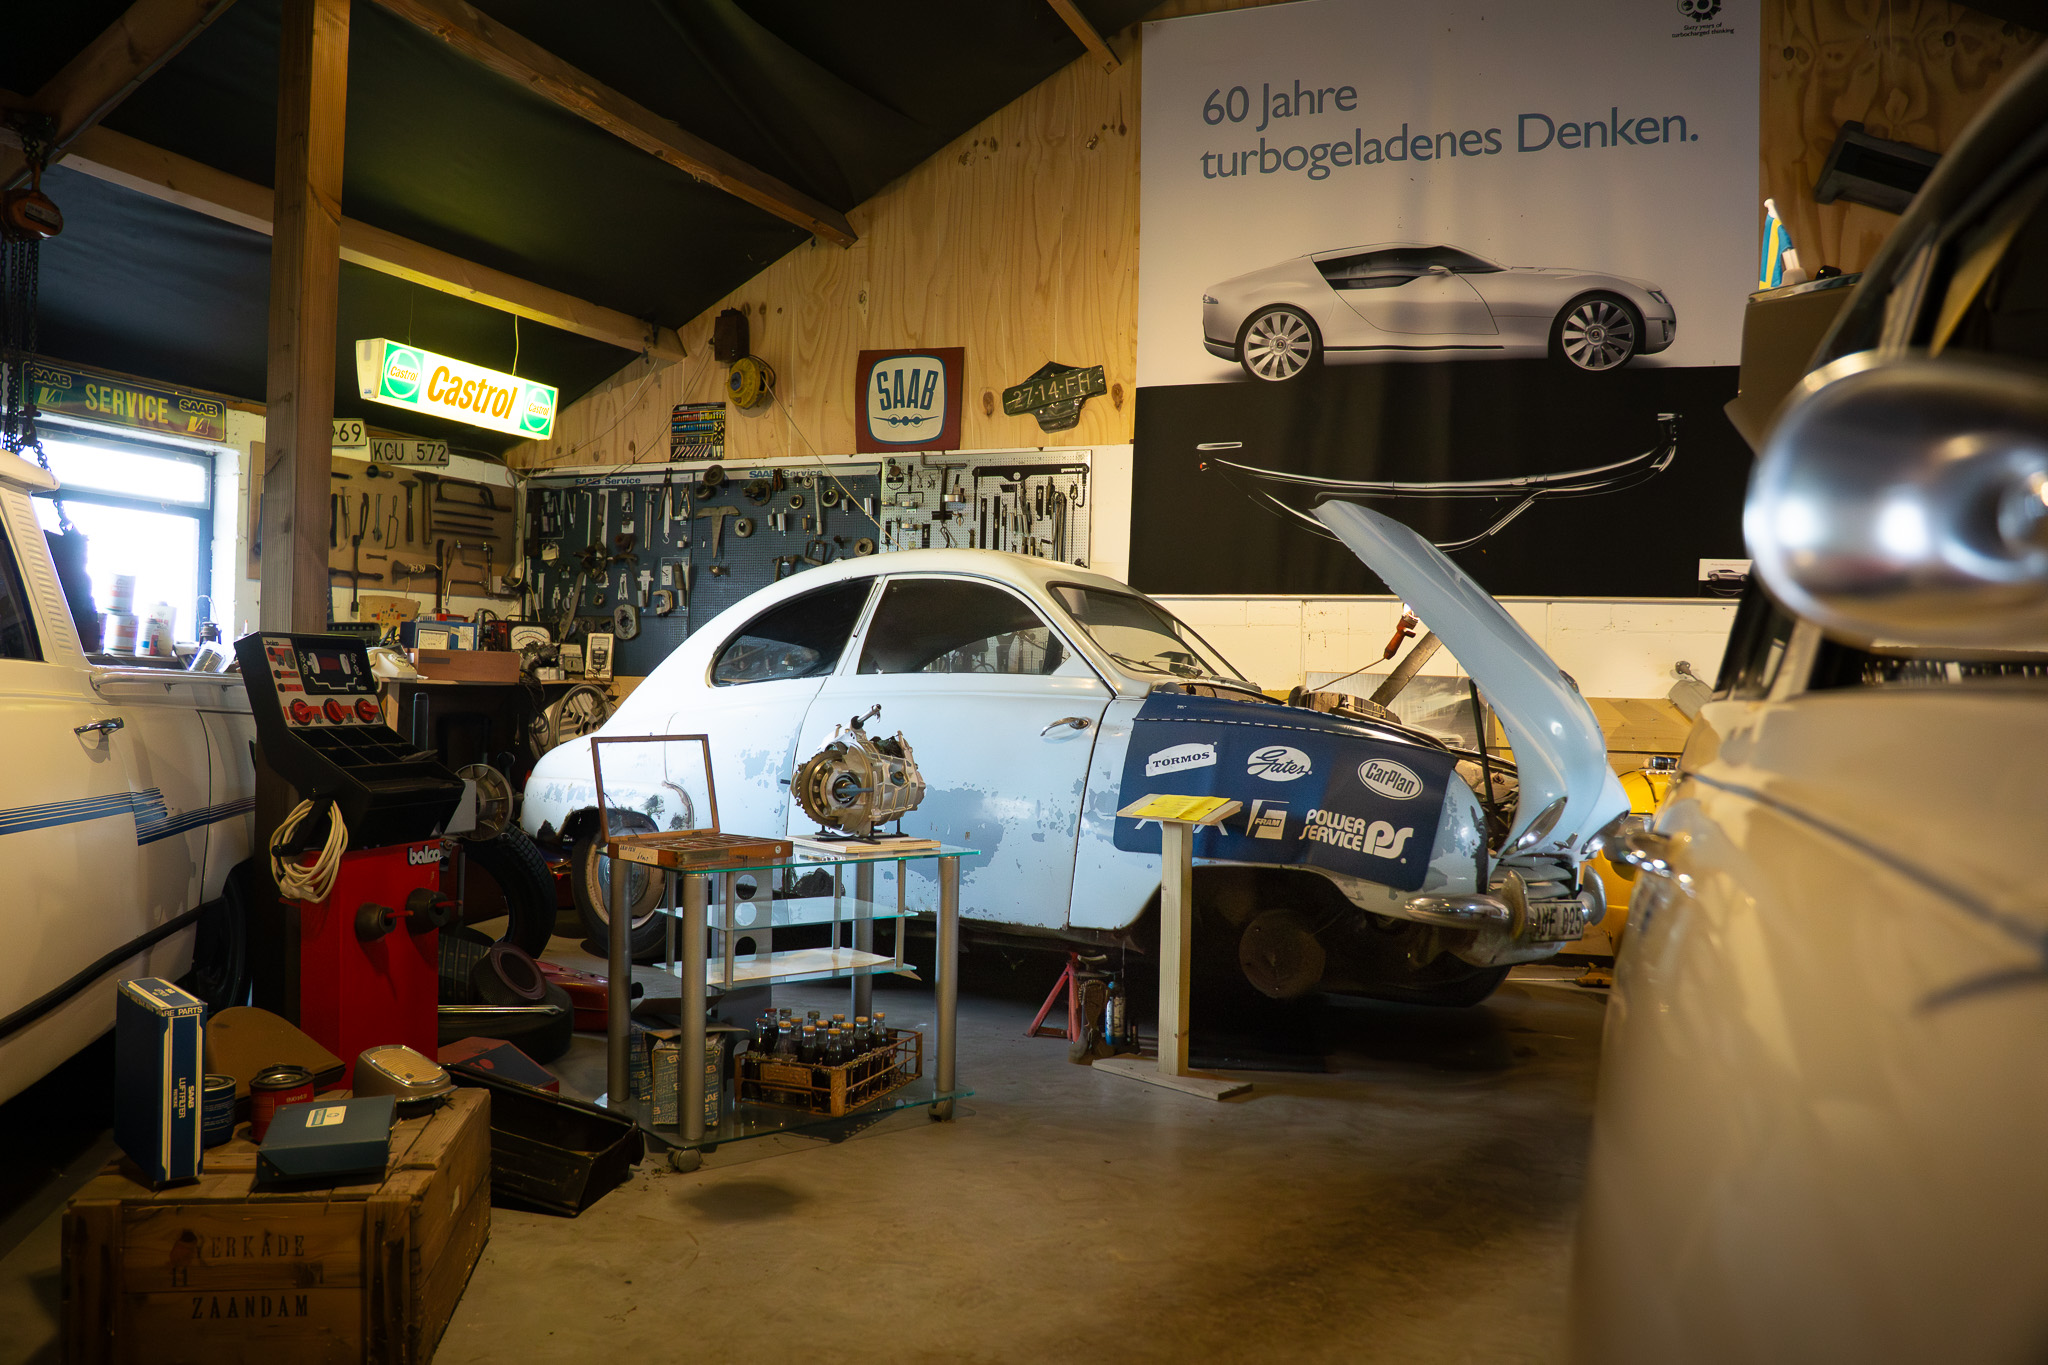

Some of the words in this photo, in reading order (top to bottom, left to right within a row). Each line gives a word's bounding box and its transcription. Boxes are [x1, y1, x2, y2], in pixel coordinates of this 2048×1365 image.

[1202, 85, 1250, 126] 60
[1255, 79, 1358, 132] Jahre
[1199, 122, 1503, 181] turbogeladenes
[1517, 106, 1699, 153] Denken.
[31, 367, 72, 389] SAAB
[390, 364, 419, 382] Castrol
[427, 364, 519, 420] Castrol
[876, 368, 939, 412] SAAB
[1012, 373, 1091, 410] 27-14-FH
[85, 382, 169, 425] SERVICE
[179, 398, 218, 418] SAAB
[528, 401, 550, 416] Castrol
[372, 440, 405, 462] KCU
[416, 442, 447, 463] 572
[604, 475, 641, 485] Service
[782, 468, 823, 478] Service
[1152, 751, 1210, 768] TORMOS
[1248, 749, 1307, 776] Gates
[1365, 762, 1415, 795] CarPlan
[1254, 817, 1282, 827] FRAM
[1305, 808, 1366, 836] POWER
[1298, 824, 1364, 852] SERVICE
[1362, 820, 1415, 860] PS
[407, 845, 441, 866] balco
[178, 1006, 203, 1016] PARTS
[191, 1294, 309, 1320] ZAANDAM
